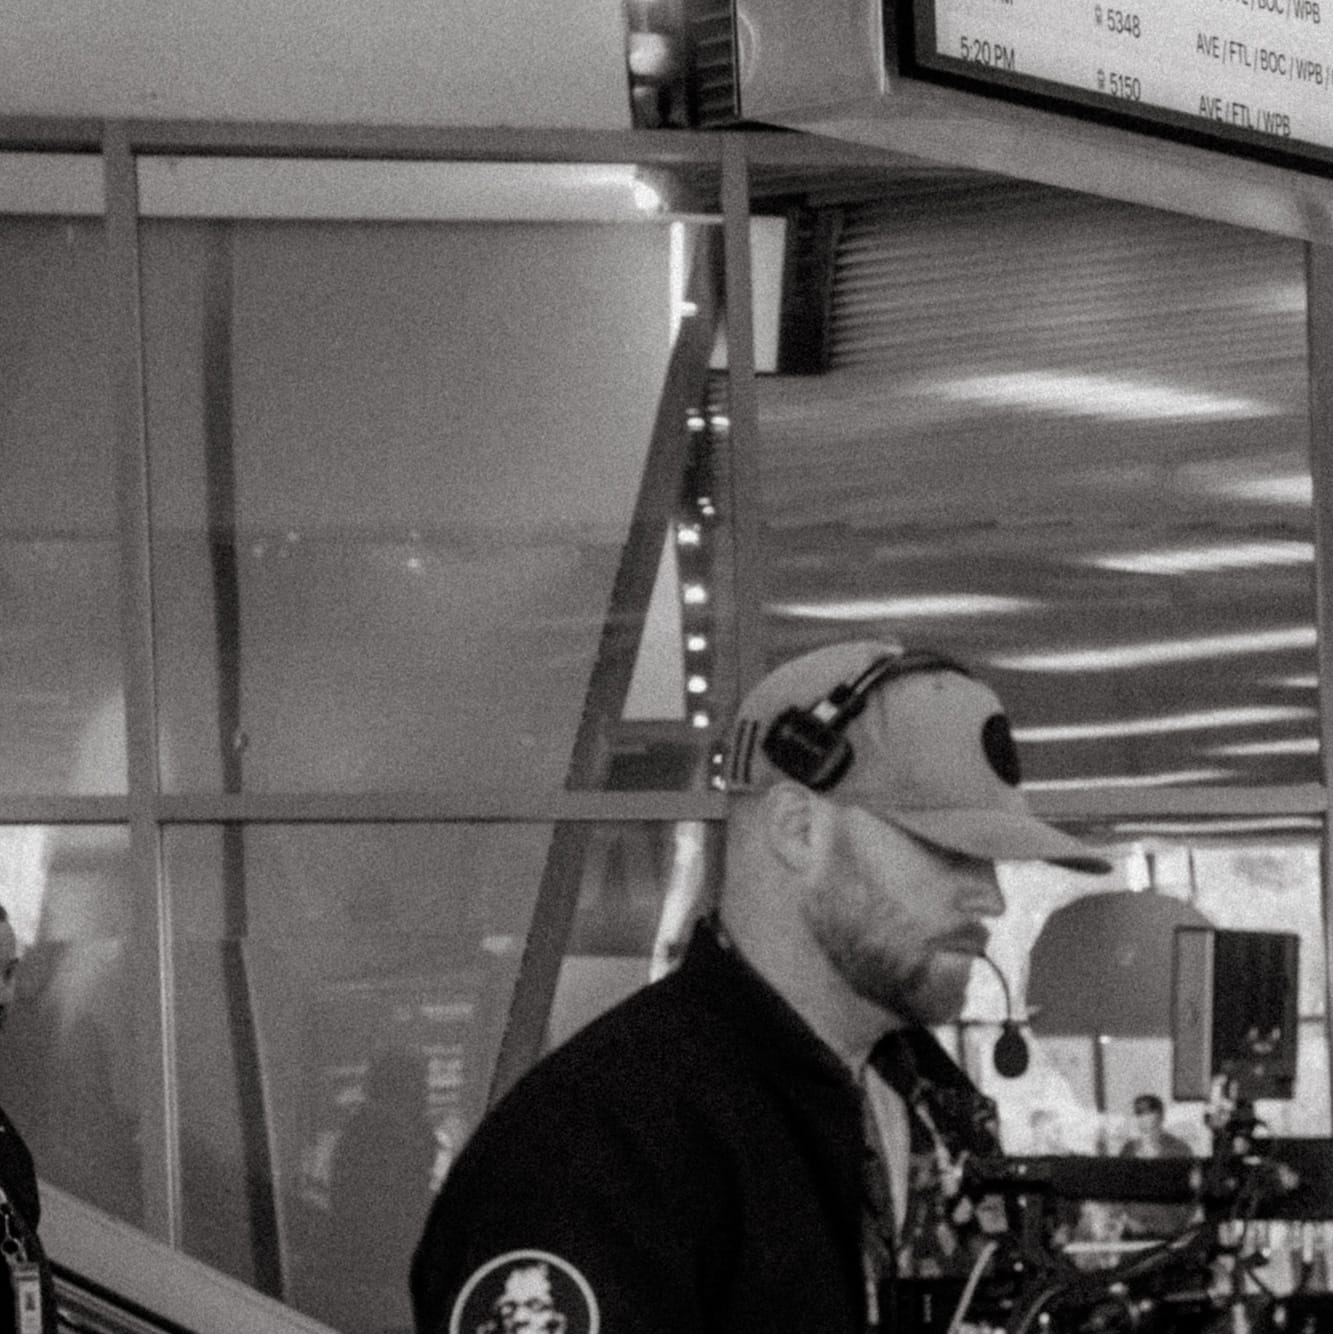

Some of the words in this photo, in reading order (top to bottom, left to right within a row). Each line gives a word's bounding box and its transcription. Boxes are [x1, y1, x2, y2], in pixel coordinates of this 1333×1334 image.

[1106, 8, 1142, 39] 5348
[959, 35, 992, 66] 5:20
[993, 44, 1016, 72] PM
[1108, 72, 1142, 101] 5150
